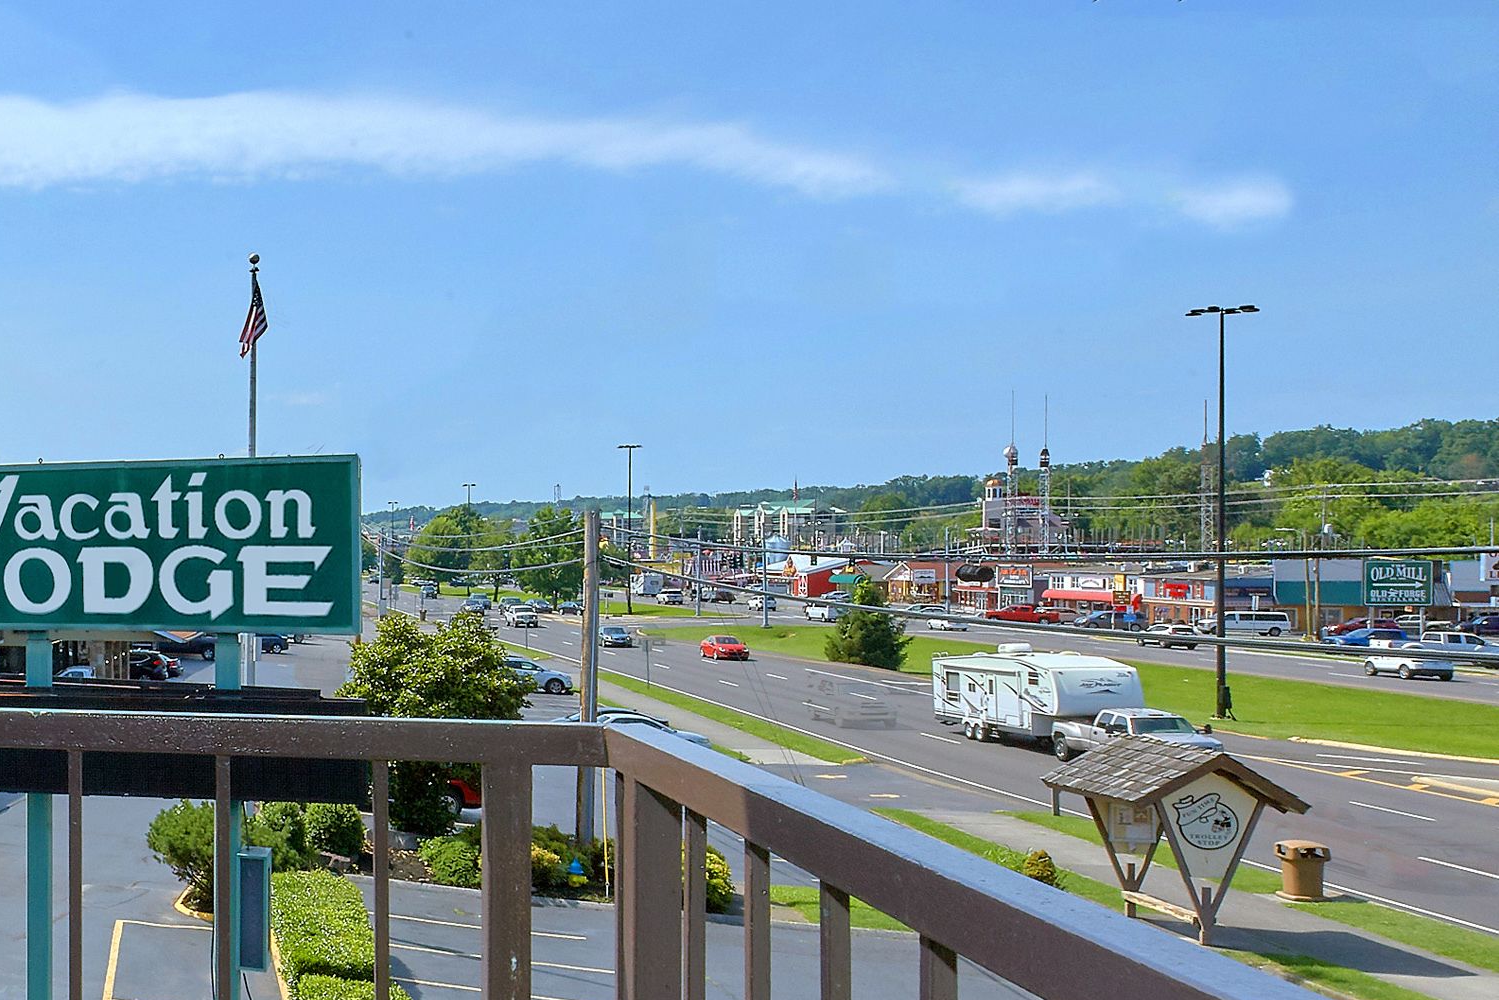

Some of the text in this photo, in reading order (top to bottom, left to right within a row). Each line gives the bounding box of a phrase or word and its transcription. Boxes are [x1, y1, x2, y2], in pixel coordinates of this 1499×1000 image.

[1370, 566, 1427, 581] OLD MILL
[1370, 589, 1427, 598] OLD FORGE
